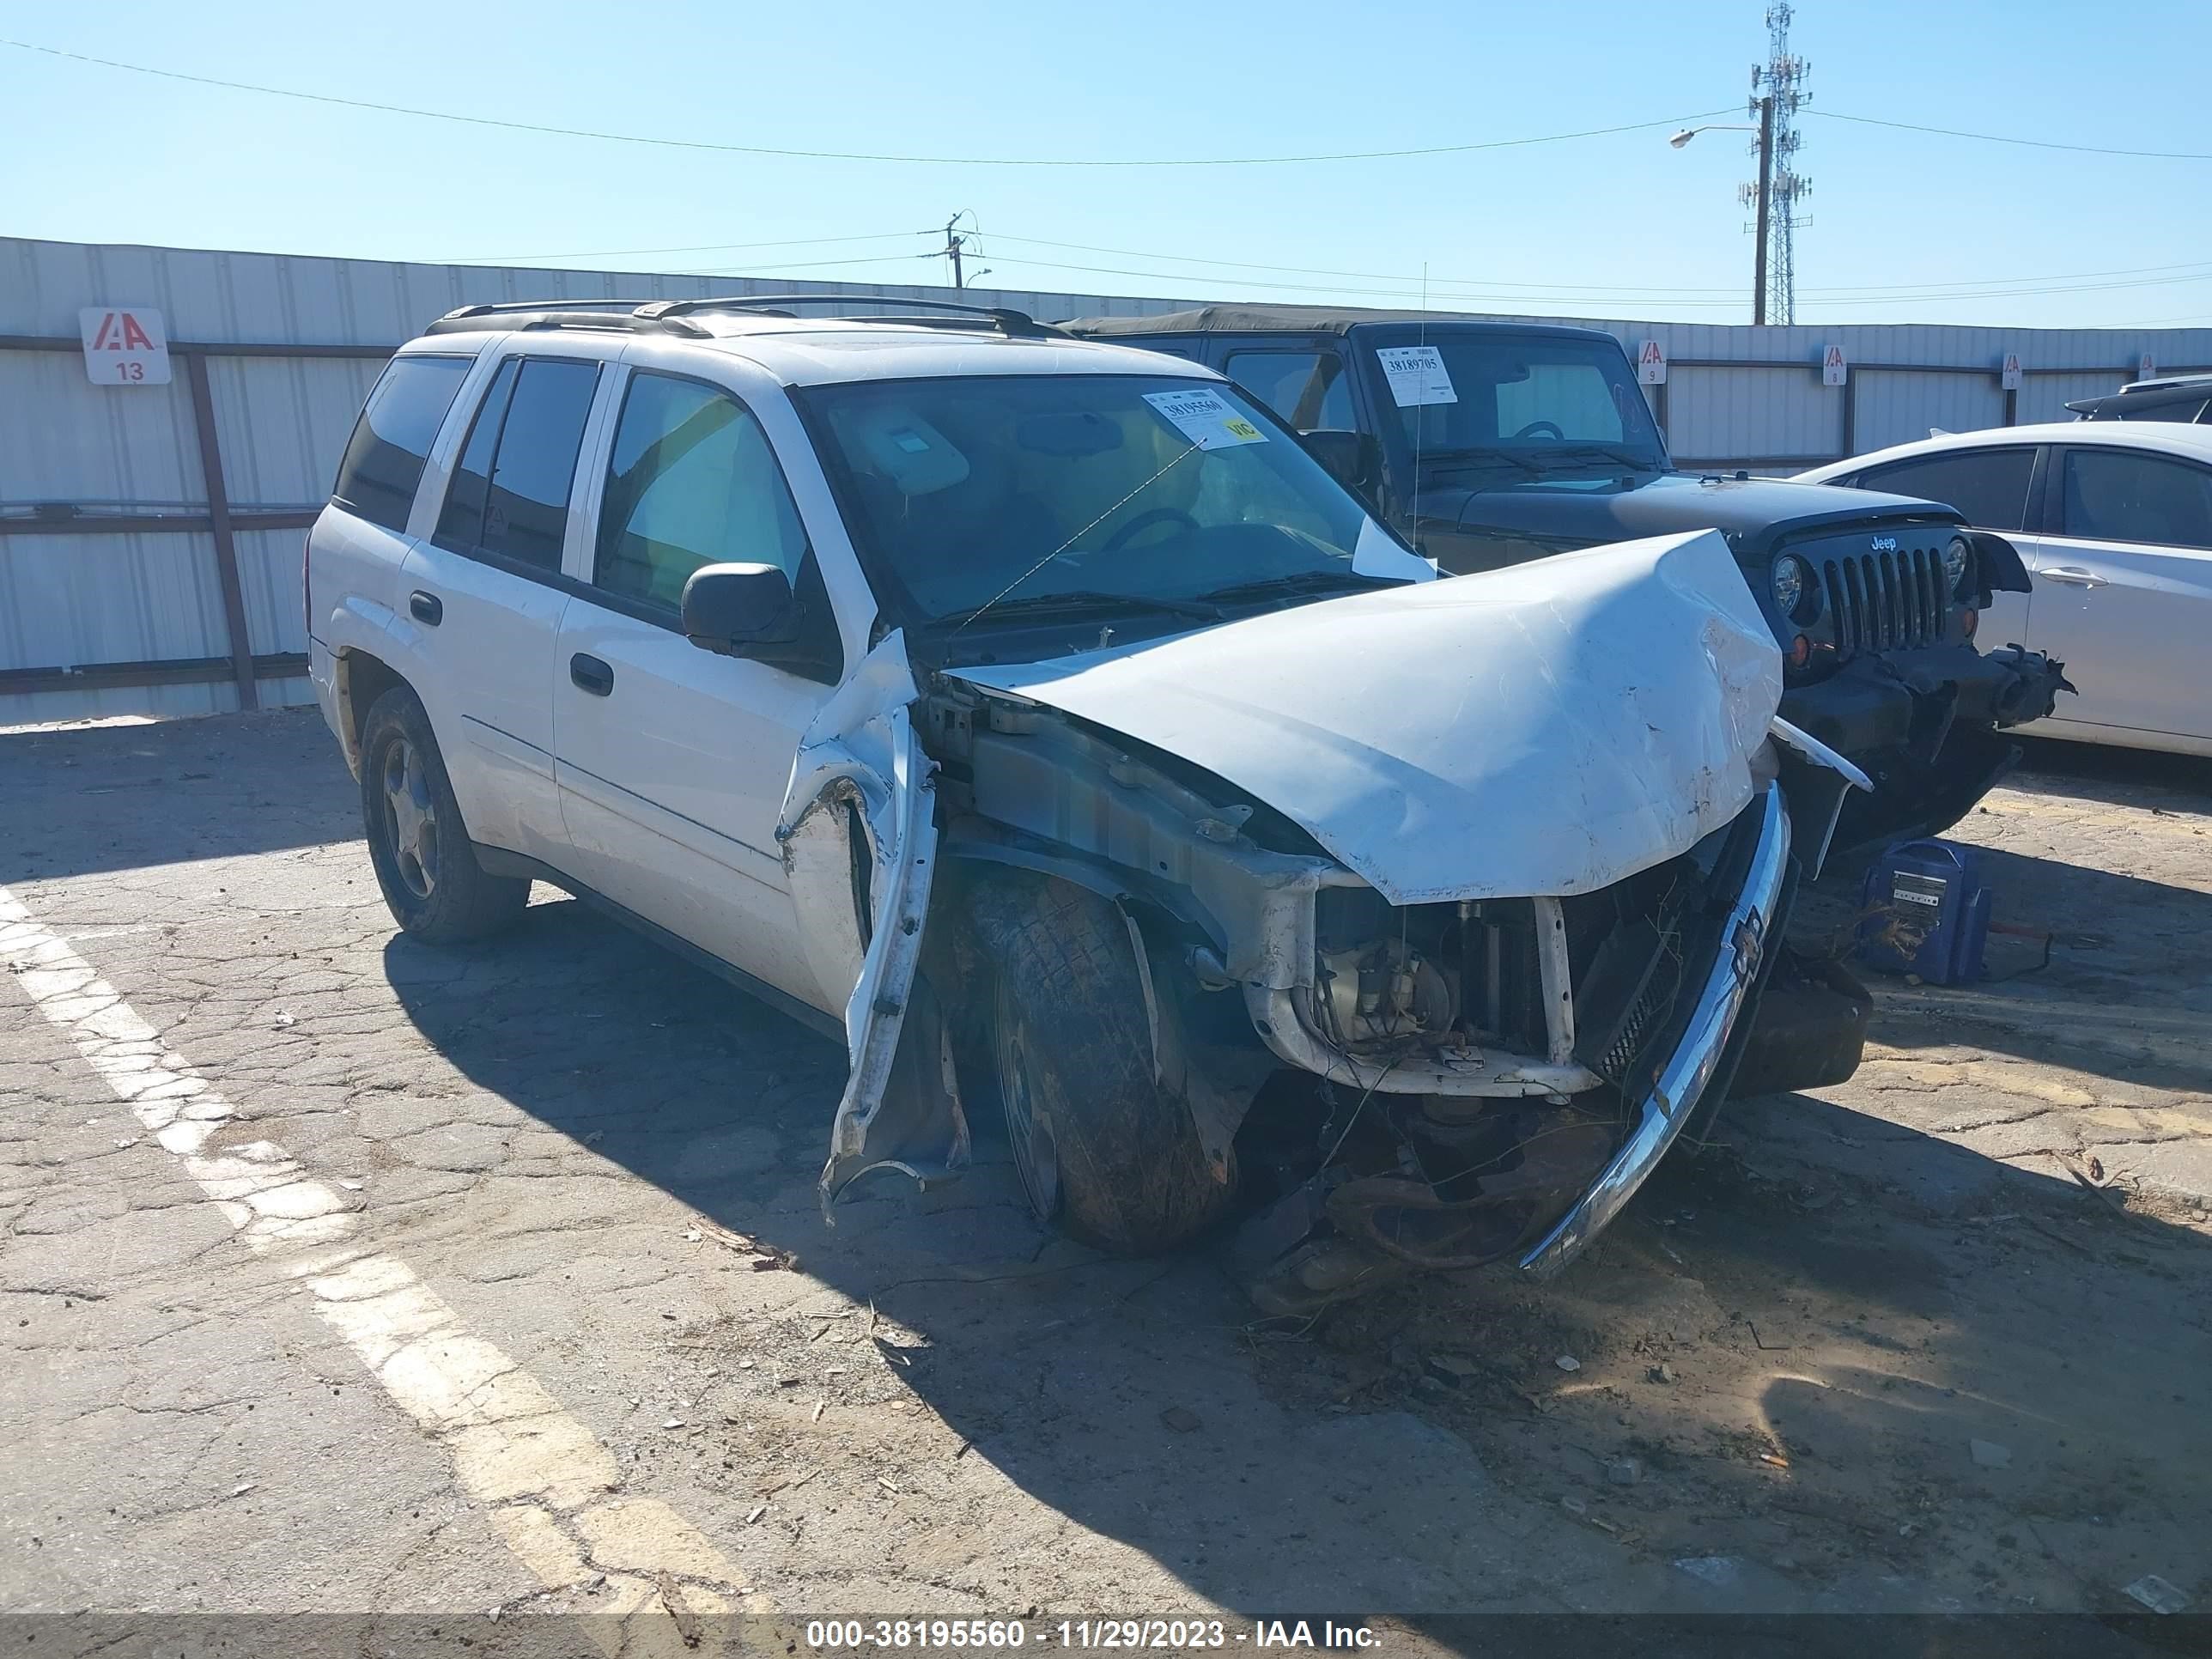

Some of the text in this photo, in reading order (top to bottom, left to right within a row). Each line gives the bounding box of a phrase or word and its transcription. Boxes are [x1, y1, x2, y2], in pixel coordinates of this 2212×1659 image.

[116, 362, 143, 380] 13
[1389, 358, 1437, 372] 38189705
[1649, 370, 1656, 381] 9
[1164, 400, 1222, 416] 38195560
[1227, 422, 1256, 436] VIC
[1871, 536, 1896, 550] Jeep
